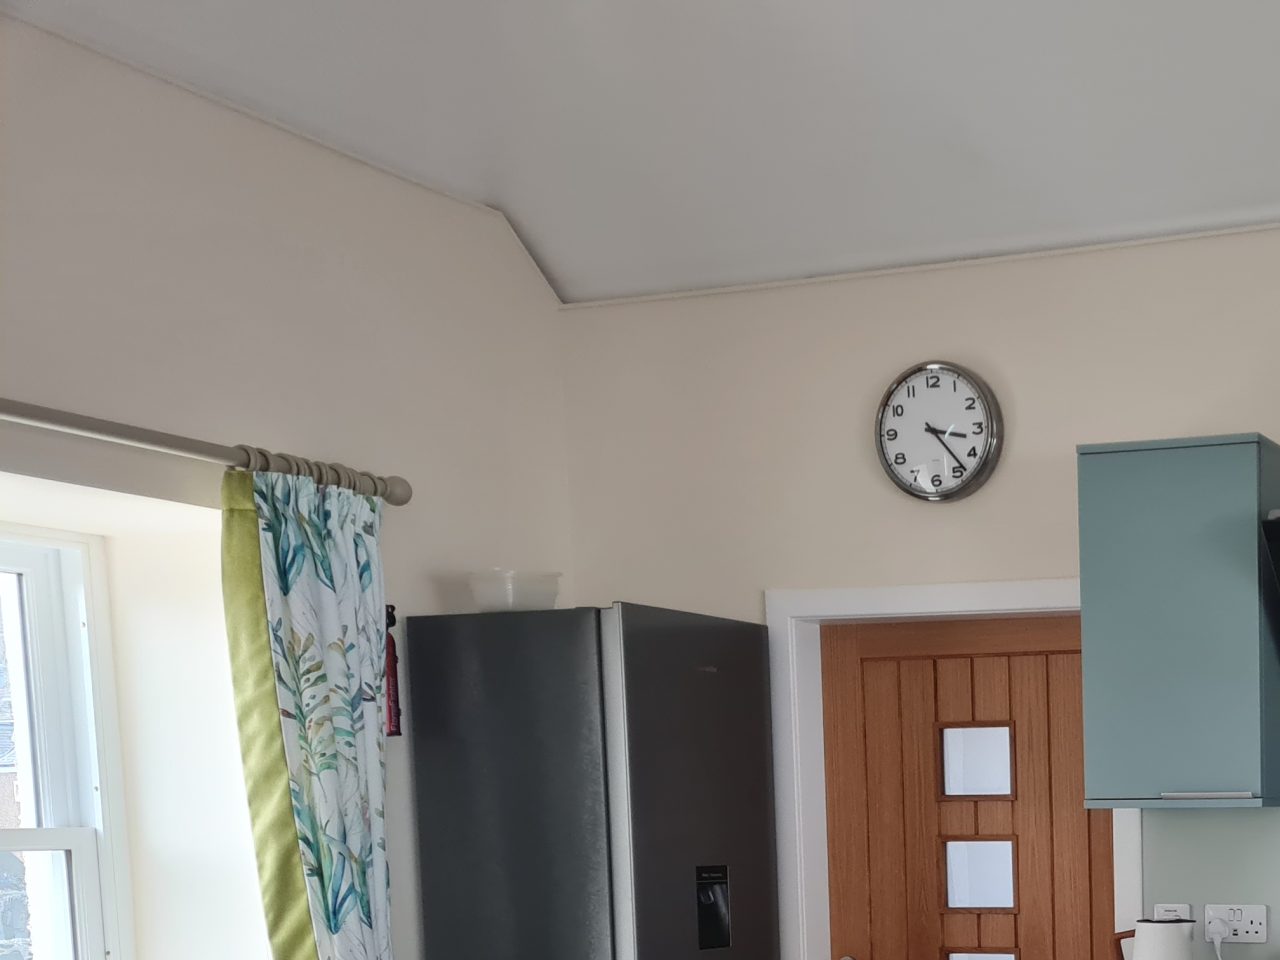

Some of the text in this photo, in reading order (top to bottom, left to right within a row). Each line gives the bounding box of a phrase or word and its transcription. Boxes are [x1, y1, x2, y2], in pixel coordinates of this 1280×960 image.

[926, 375, 940, 388] 12
[953, 380, 957, 392] 1
[907, 385, 915, 398] 11
[964, 397, 976, 410] 2
[892, 404, 904, 417] 10
[886, 428, 898, 441] 9
[972, 422, 983, 435] 3
[894, 452, 906, 465] 8
[967, 446, 978, 459] 4
[910, 469, 920, 483] 7
[952, 465, 964, 478] 5
[931, 474, 942, 487] 6
